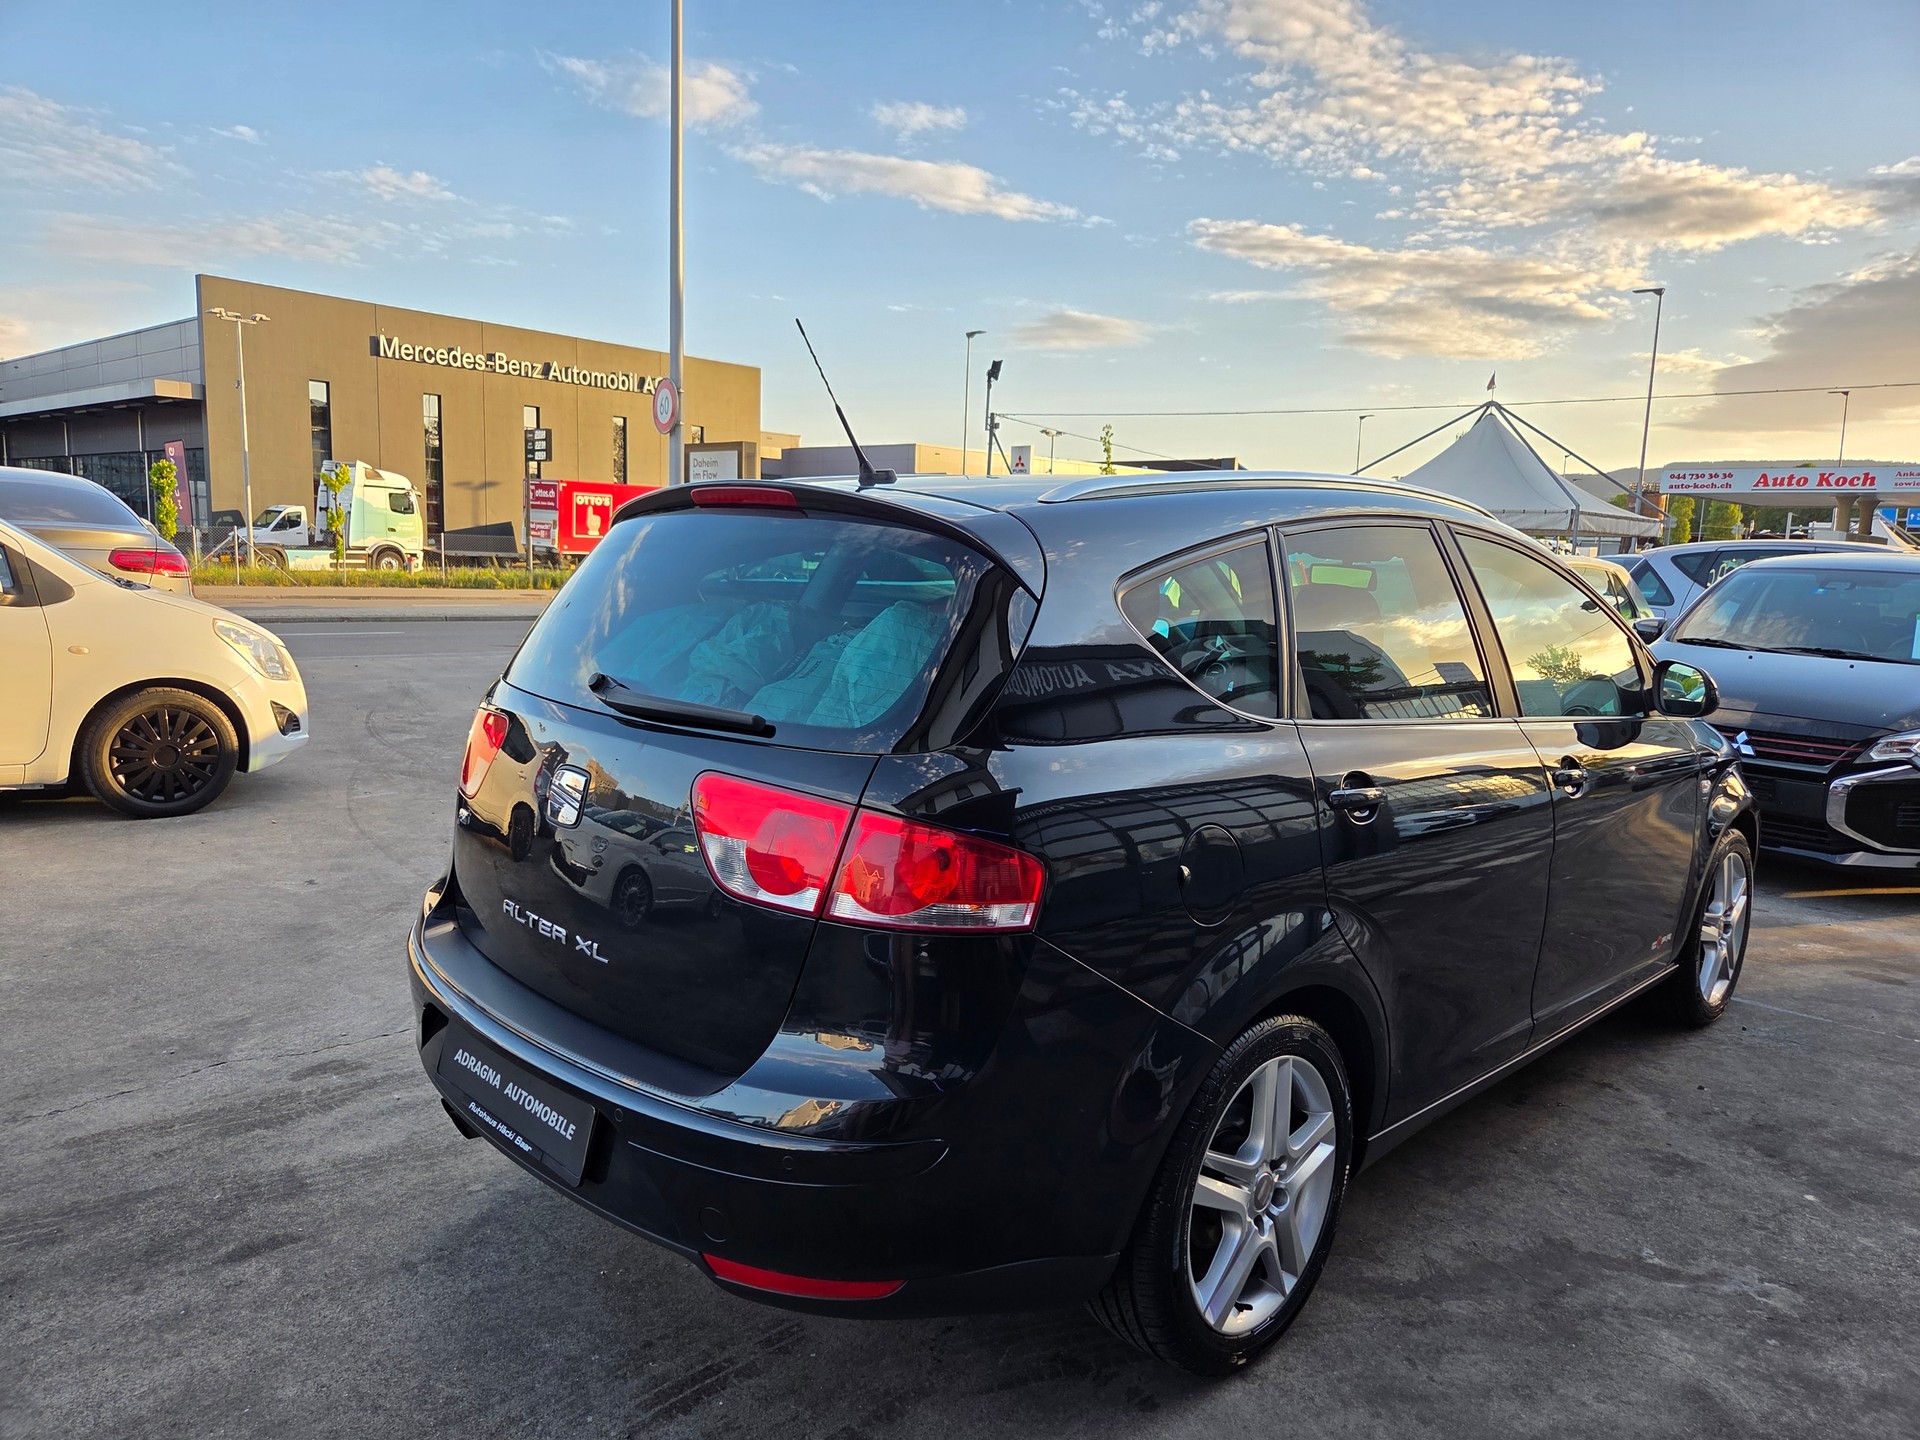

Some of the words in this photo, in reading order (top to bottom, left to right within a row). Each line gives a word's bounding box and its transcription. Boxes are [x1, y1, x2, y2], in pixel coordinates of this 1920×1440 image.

[379, 334, 544, 379] Mercedes-Benz
[548, 360, 638, 393] Automobil
[659, 395, 670, 416] 60
[693, 457, 719, 468] Daheim
[693, 470, 701, 480] im
[702, 470, 718, 480] Flow
[1688, 472, 1706, 480] 730
[1707, 472, 1720, 480] 36
[1721, 472, 1734, 480] 36
[1753, 473, 1809, 488] Auto
[1816, 472, 1877, 488] Koch
[1668, 482, 1732, 490] auto-koch.ch
[576, 495, 611, 507] OTTO'S
[575, 934, 609, 964] XL
[453, 1048, 502, 1089] ADRAGNA
[503, 1082, 577, 1141] AUTOMOBILE
[468, 1101, 498, 1128] Autohaus
[514, 1135, 533, 1152] Baar
